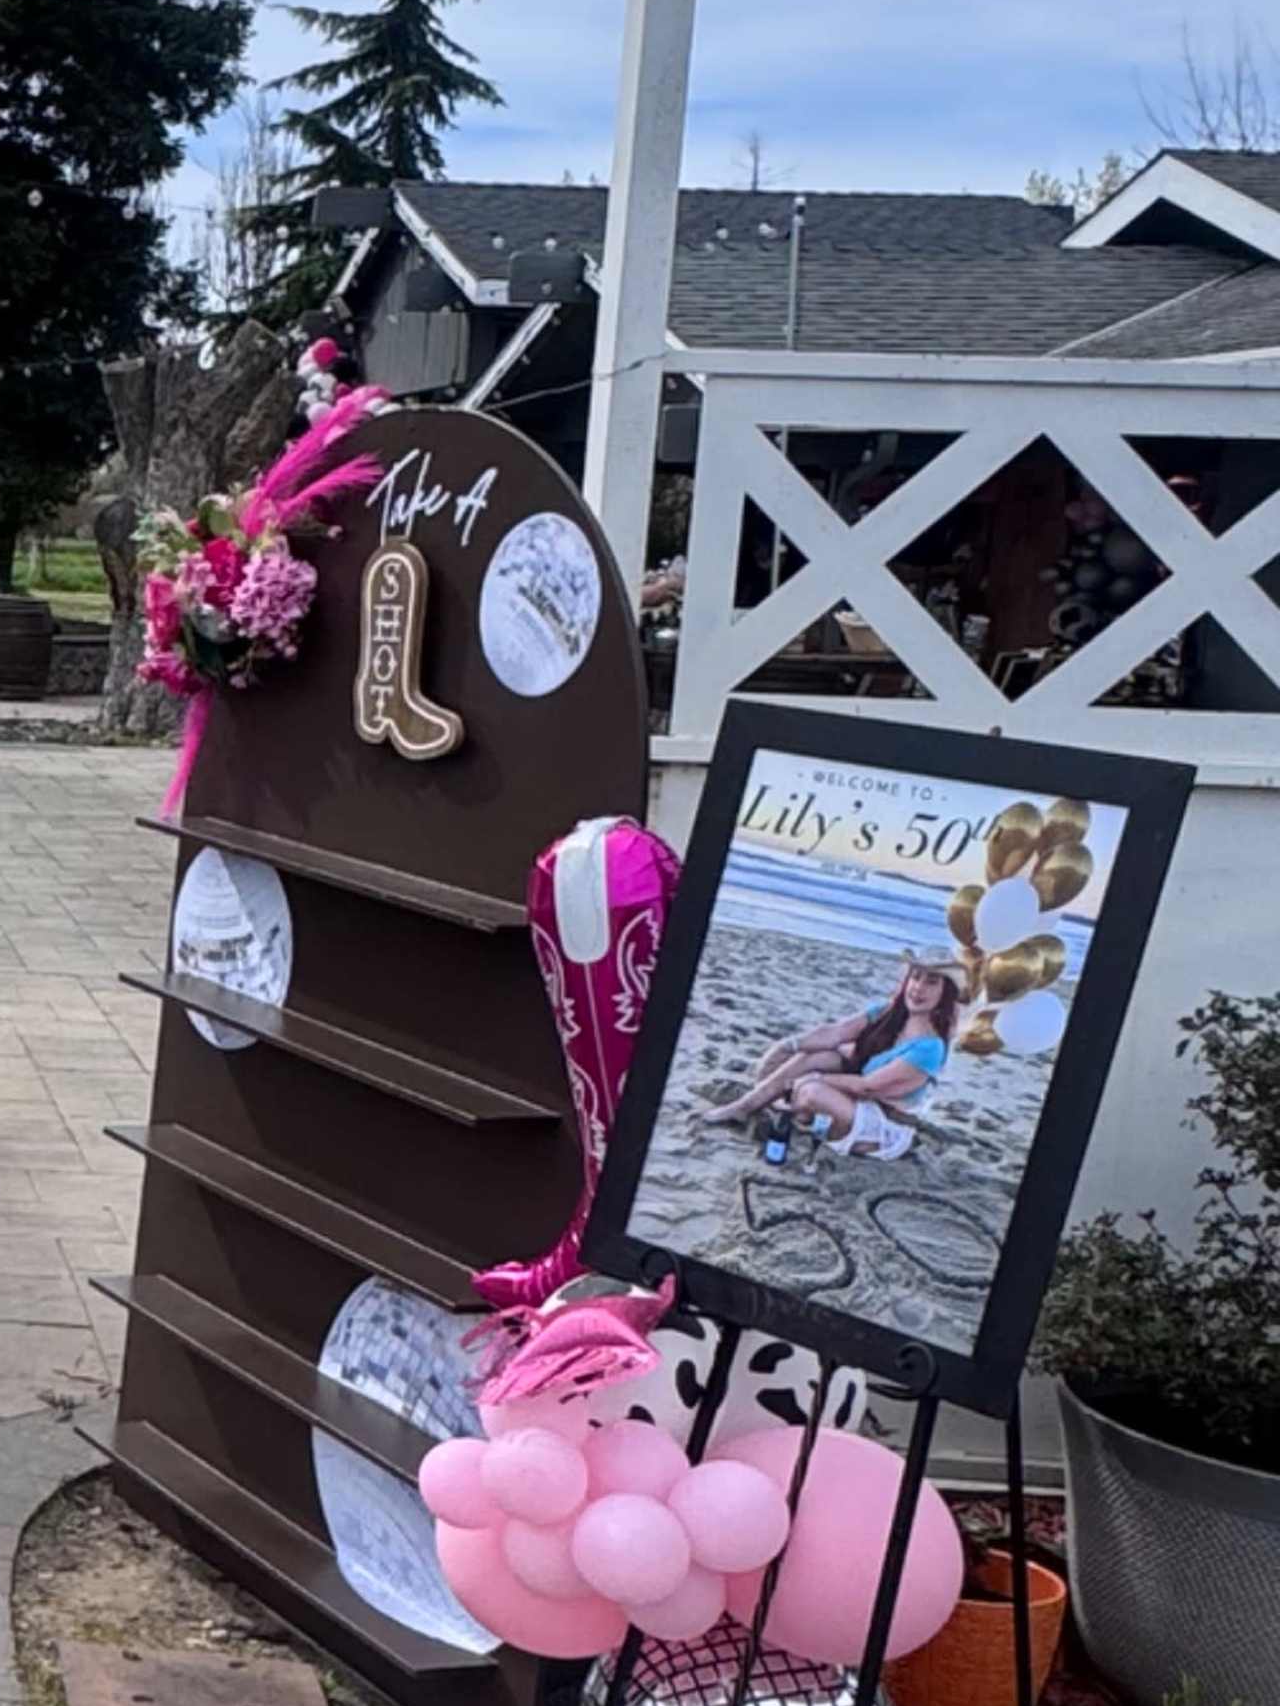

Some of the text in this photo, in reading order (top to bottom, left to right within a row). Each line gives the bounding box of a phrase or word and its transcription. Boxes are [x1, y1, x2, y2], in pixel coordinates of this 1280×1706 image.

[365, 447, 498, 547] Take A
[368, 561, 404, 723] SHOT
[740, 784, 880, 856] Lily's
[812, 770, 934, 802] WELCOME TO
[742, 1177, 1001, 1297] 50
